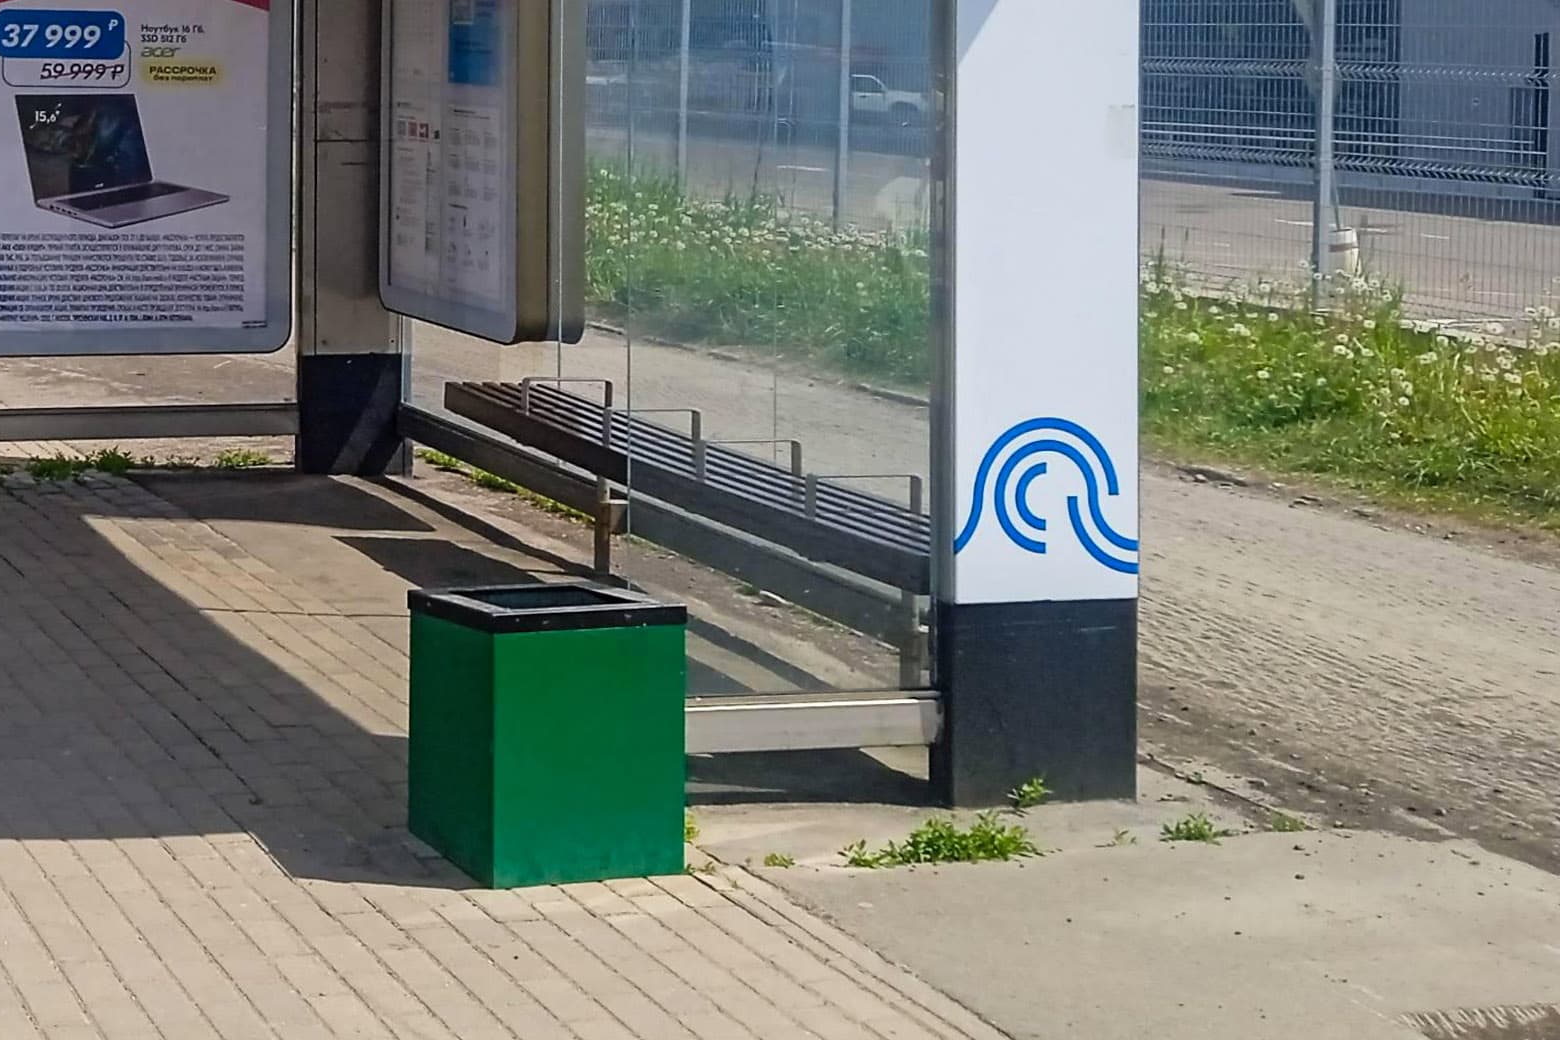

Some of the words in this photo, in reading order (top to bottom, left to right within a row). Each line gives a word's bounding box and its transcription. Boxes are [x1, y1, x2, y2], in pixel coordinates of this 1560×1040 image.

[140, 23, 180, 35] Ноутбук
[140, 34, 159, 44] SSD
[141, 46, 182, 58] acer
[149, 65, 217, 75] РАССРОЧКА
